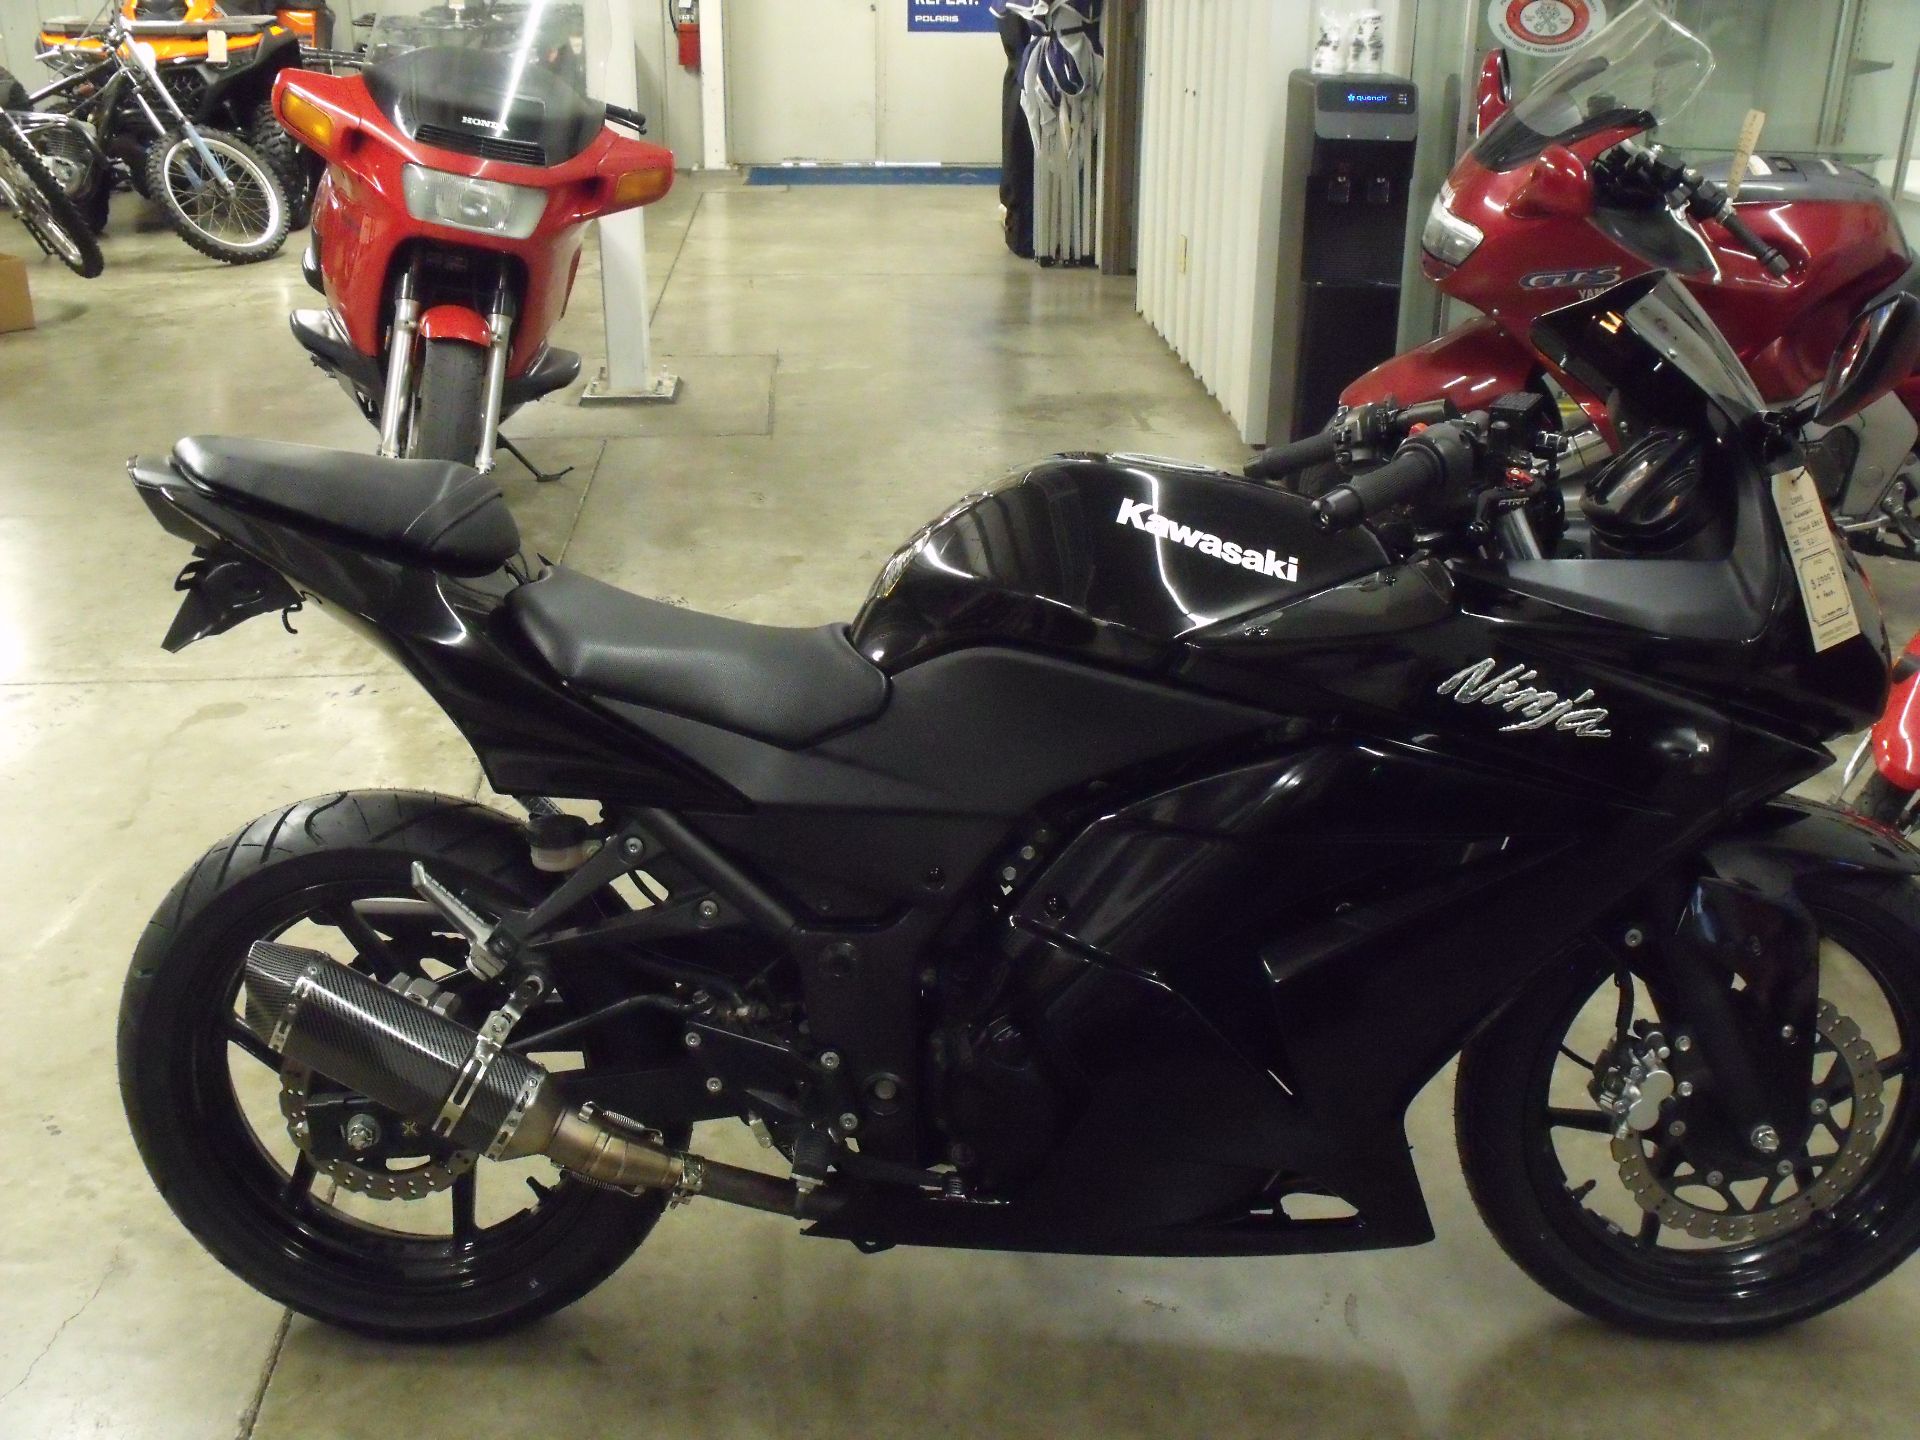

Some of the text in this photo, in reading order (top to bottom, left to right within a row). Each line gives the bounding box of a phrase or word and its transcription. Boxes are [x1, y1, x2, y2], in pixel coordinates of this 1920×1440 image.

[915, 15, 960, 23] POLARIS
[461, 116, 509, 131] HONDA
[1521, 265, 1622, 289] GTS
[1116, 497, 1299, 582] Kawasaki
[1437, 657, 1612, 738] Ninja
